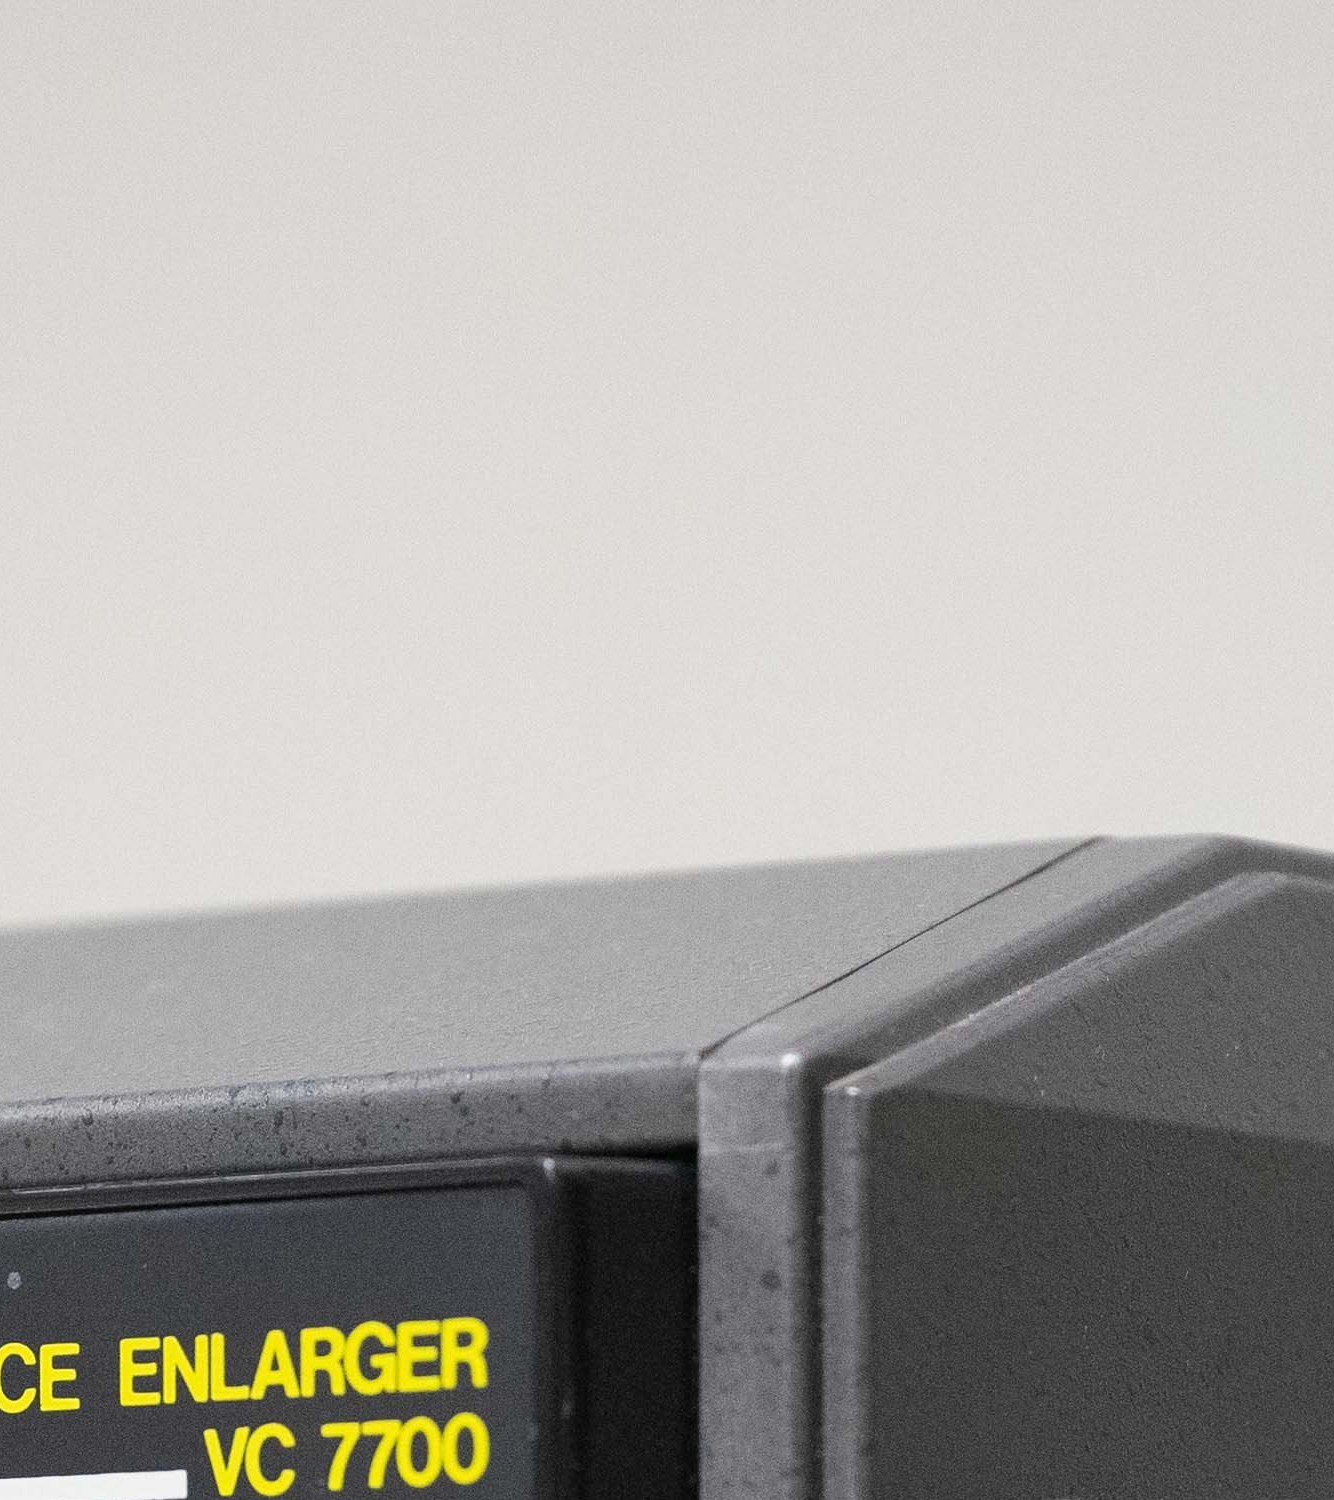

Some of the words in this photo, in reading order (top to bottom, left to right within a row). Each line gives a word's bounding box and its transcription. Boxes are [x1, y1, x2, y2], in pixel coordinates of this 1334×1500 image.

[119, 1316, 490, 1407] ENLARGER
[202, 1422, 296, 1497] VC
[319, 1411, 491, 1492] 7700
